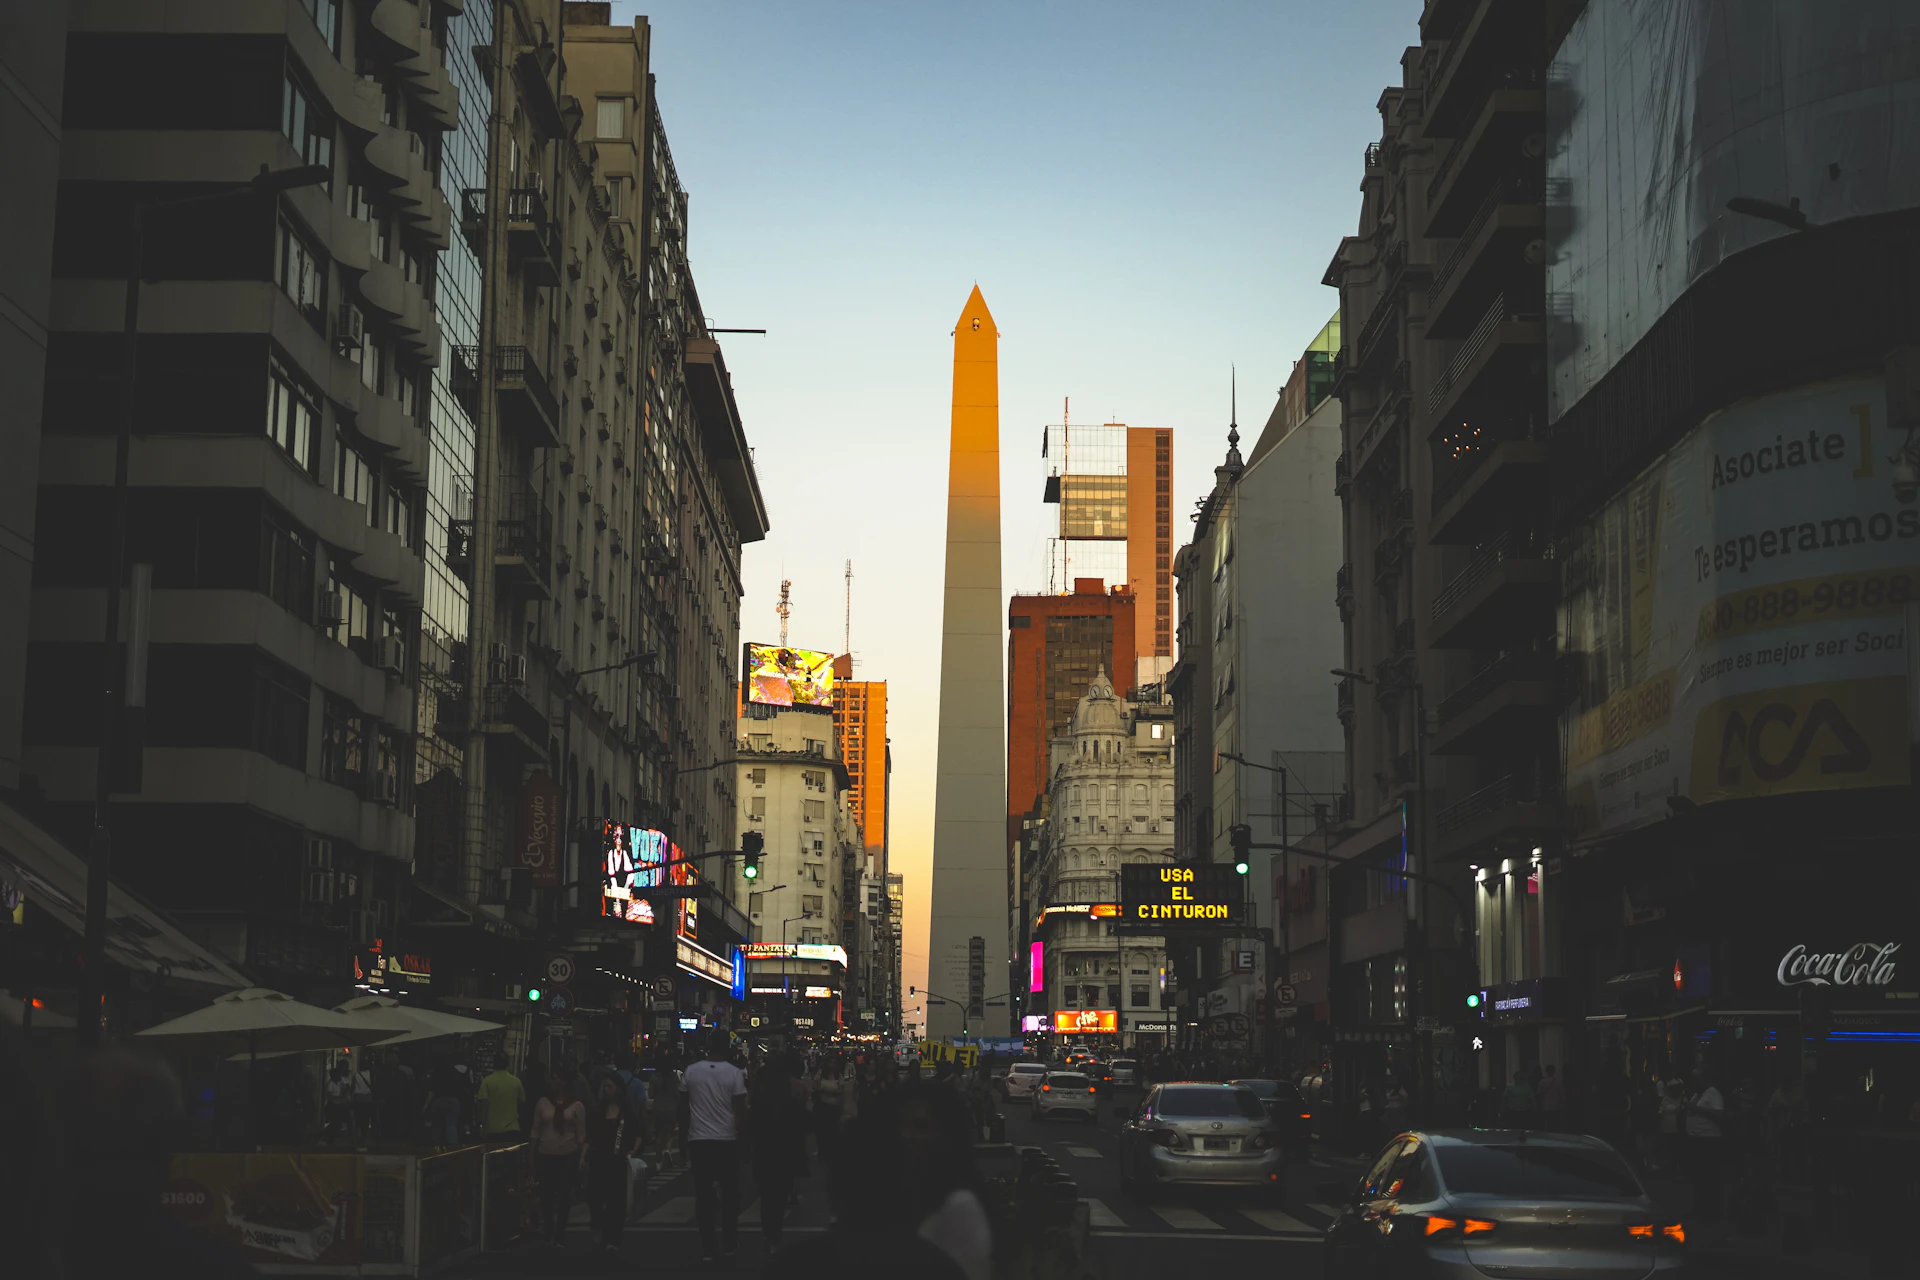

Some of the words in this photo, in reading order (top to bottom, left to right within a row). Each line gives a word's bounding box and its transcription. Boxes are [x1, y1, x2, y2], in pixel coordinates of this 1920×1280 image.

[1711, 429, 1845, 490] Asociate
[1694, 544, 1710, 584] Te
[1713, 509, 1920, 573] esperamos
[1700, 656, 1734, 684] Siempre
[1736, 652, 1752, 669] es
[1756, 642, 1809, 667] mejor
[1815, 637, 1848, 657] ser
[1854, 628, 1904, 652] Soci
[1160, 868, 1194, 882] USA
[1171, 886, 1194, 901] EL
[1138, 904, 1228, 918] CINTURON
[1239, 952, 1252, 968] E
[1777, 942, 1902, 986] Coca-Cola
[551, 963, 568, 977] 30
